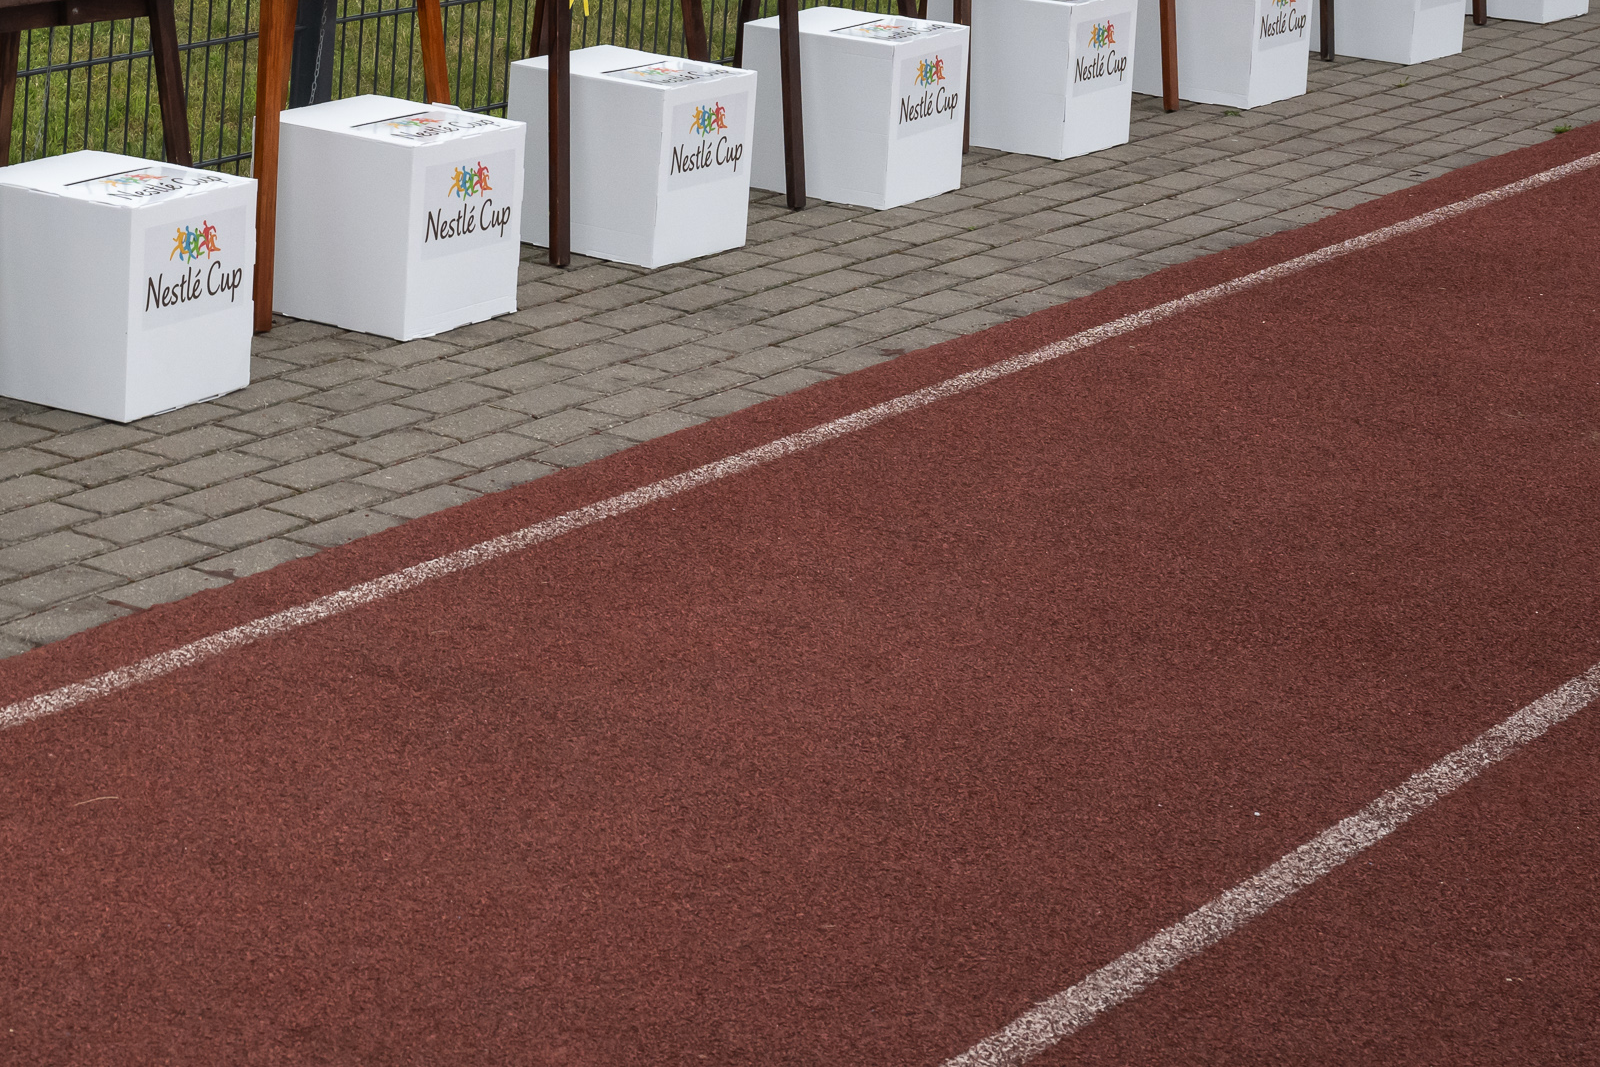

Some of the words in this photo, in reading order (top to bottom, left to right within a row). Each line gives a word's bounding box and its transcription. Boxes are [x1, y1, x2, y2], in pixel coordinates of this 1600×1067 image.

[1260, 11, 1286, 39] Nestlé
[1289, 8, 1306, 37] Cup
[1075, 53, 1104, 83] Nestlé
[1107, 50, 1126, 81] Cup
[899, 91, 933, 124] Nestlé
[936, 87, 958, 119] Cup
[671, 140, 713, 175] Nestlé
[716, 136, 743, 172] Cup
[425, 203, 476, 243] Nestlé
[480, 199, 510, 237] Cup
[145, 267, 202, 312] Nestlé
[207, 261, 242, 302] Cup
